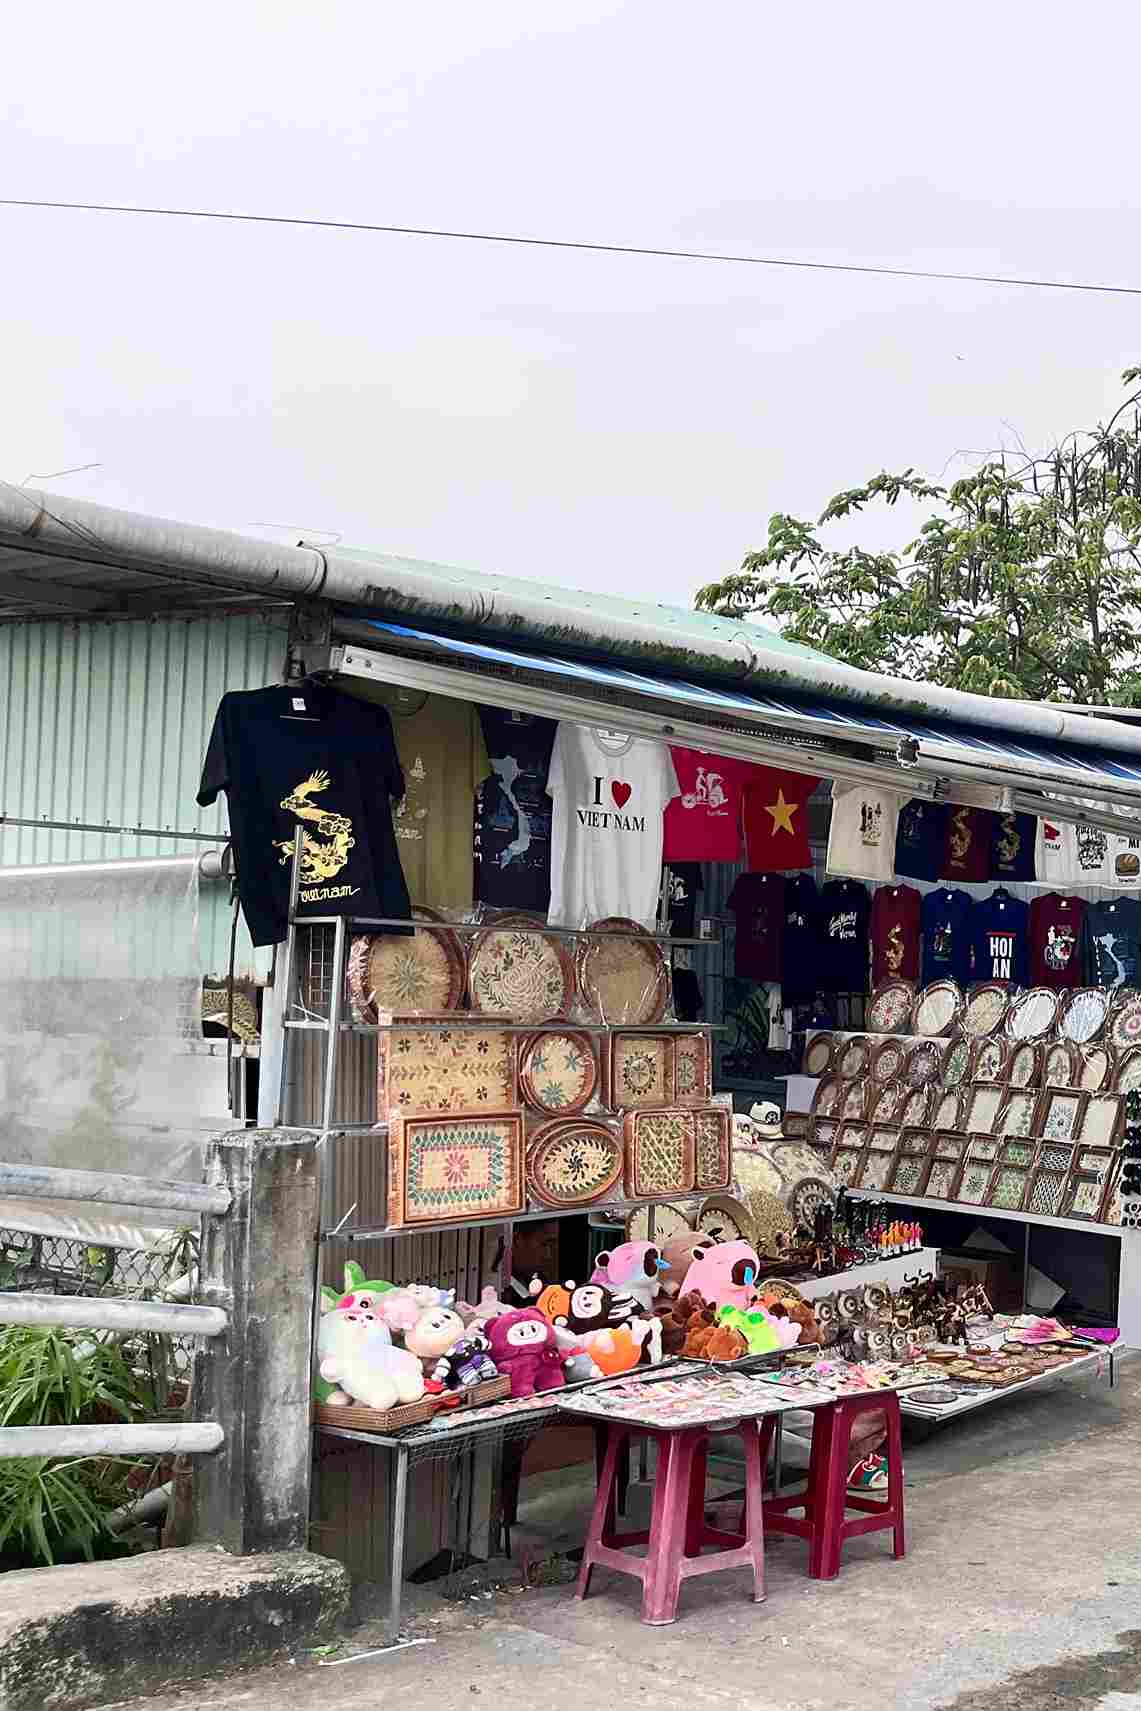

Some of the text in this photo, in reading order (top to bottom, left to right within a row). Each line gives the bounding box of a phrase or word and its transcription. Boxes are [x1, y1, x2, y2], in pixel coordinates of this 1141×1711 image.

[592, 776, 604, 805] I
[576, 809, 646, 833] VIET NAM
[989, 936, 1013, 958] HOI
[992, 958, 1011, 979] AN
